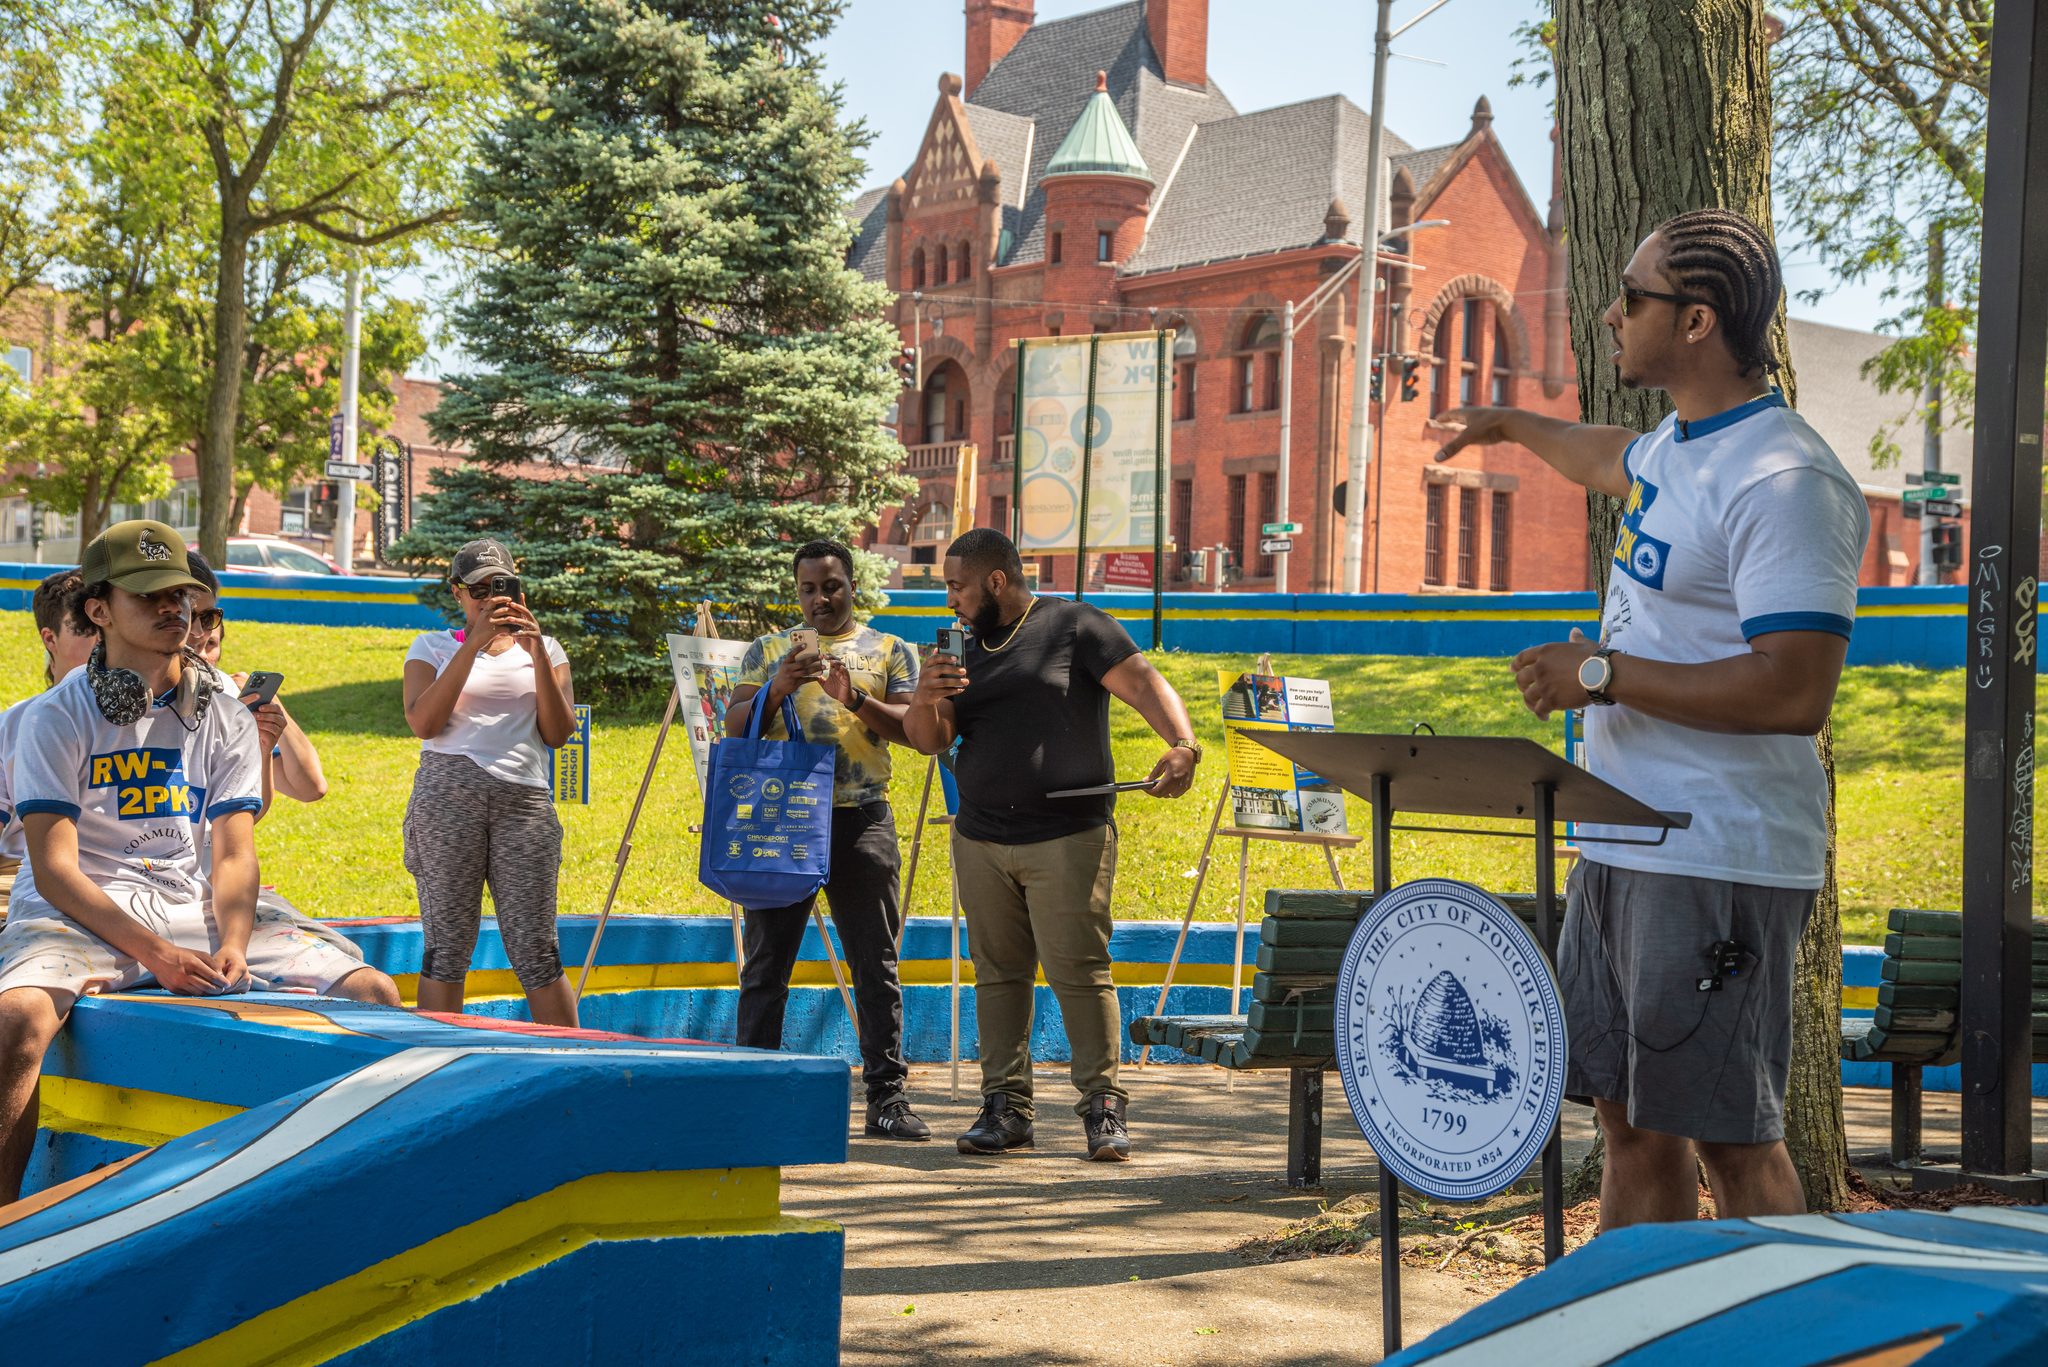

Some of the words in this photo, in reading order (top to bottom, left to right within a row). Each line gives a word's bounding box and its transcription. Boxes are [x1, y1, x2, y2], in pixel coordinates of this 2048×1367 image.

[384, 462, 399, 546] DELI
[1907, 489, 1932, 499] MARKET
[560, 747, 569, 801] MURALIST
[569, 749, 578, 800] SPONSOR
[118, 785, 191, 816] 2PK
[1306, 797, 1340, 813] COMMUNITY
[1397, 903, 1439, 928] CITY
[1447, 905, 1472, 925] OF
[1364, 926, 1393, 967] THE
[1355, 975, 1368, 1007] OF
[1478, 919, 1547, 1116] POUGHKEEPSIE
[1352, 1017, 1369, 1078] SEAL
[1421, 1106, 1467, 1136] 1799
[1384, 1120, 1472, 1172] INCORPORATED
[1477, 1146, 1503, 1168] 1854
